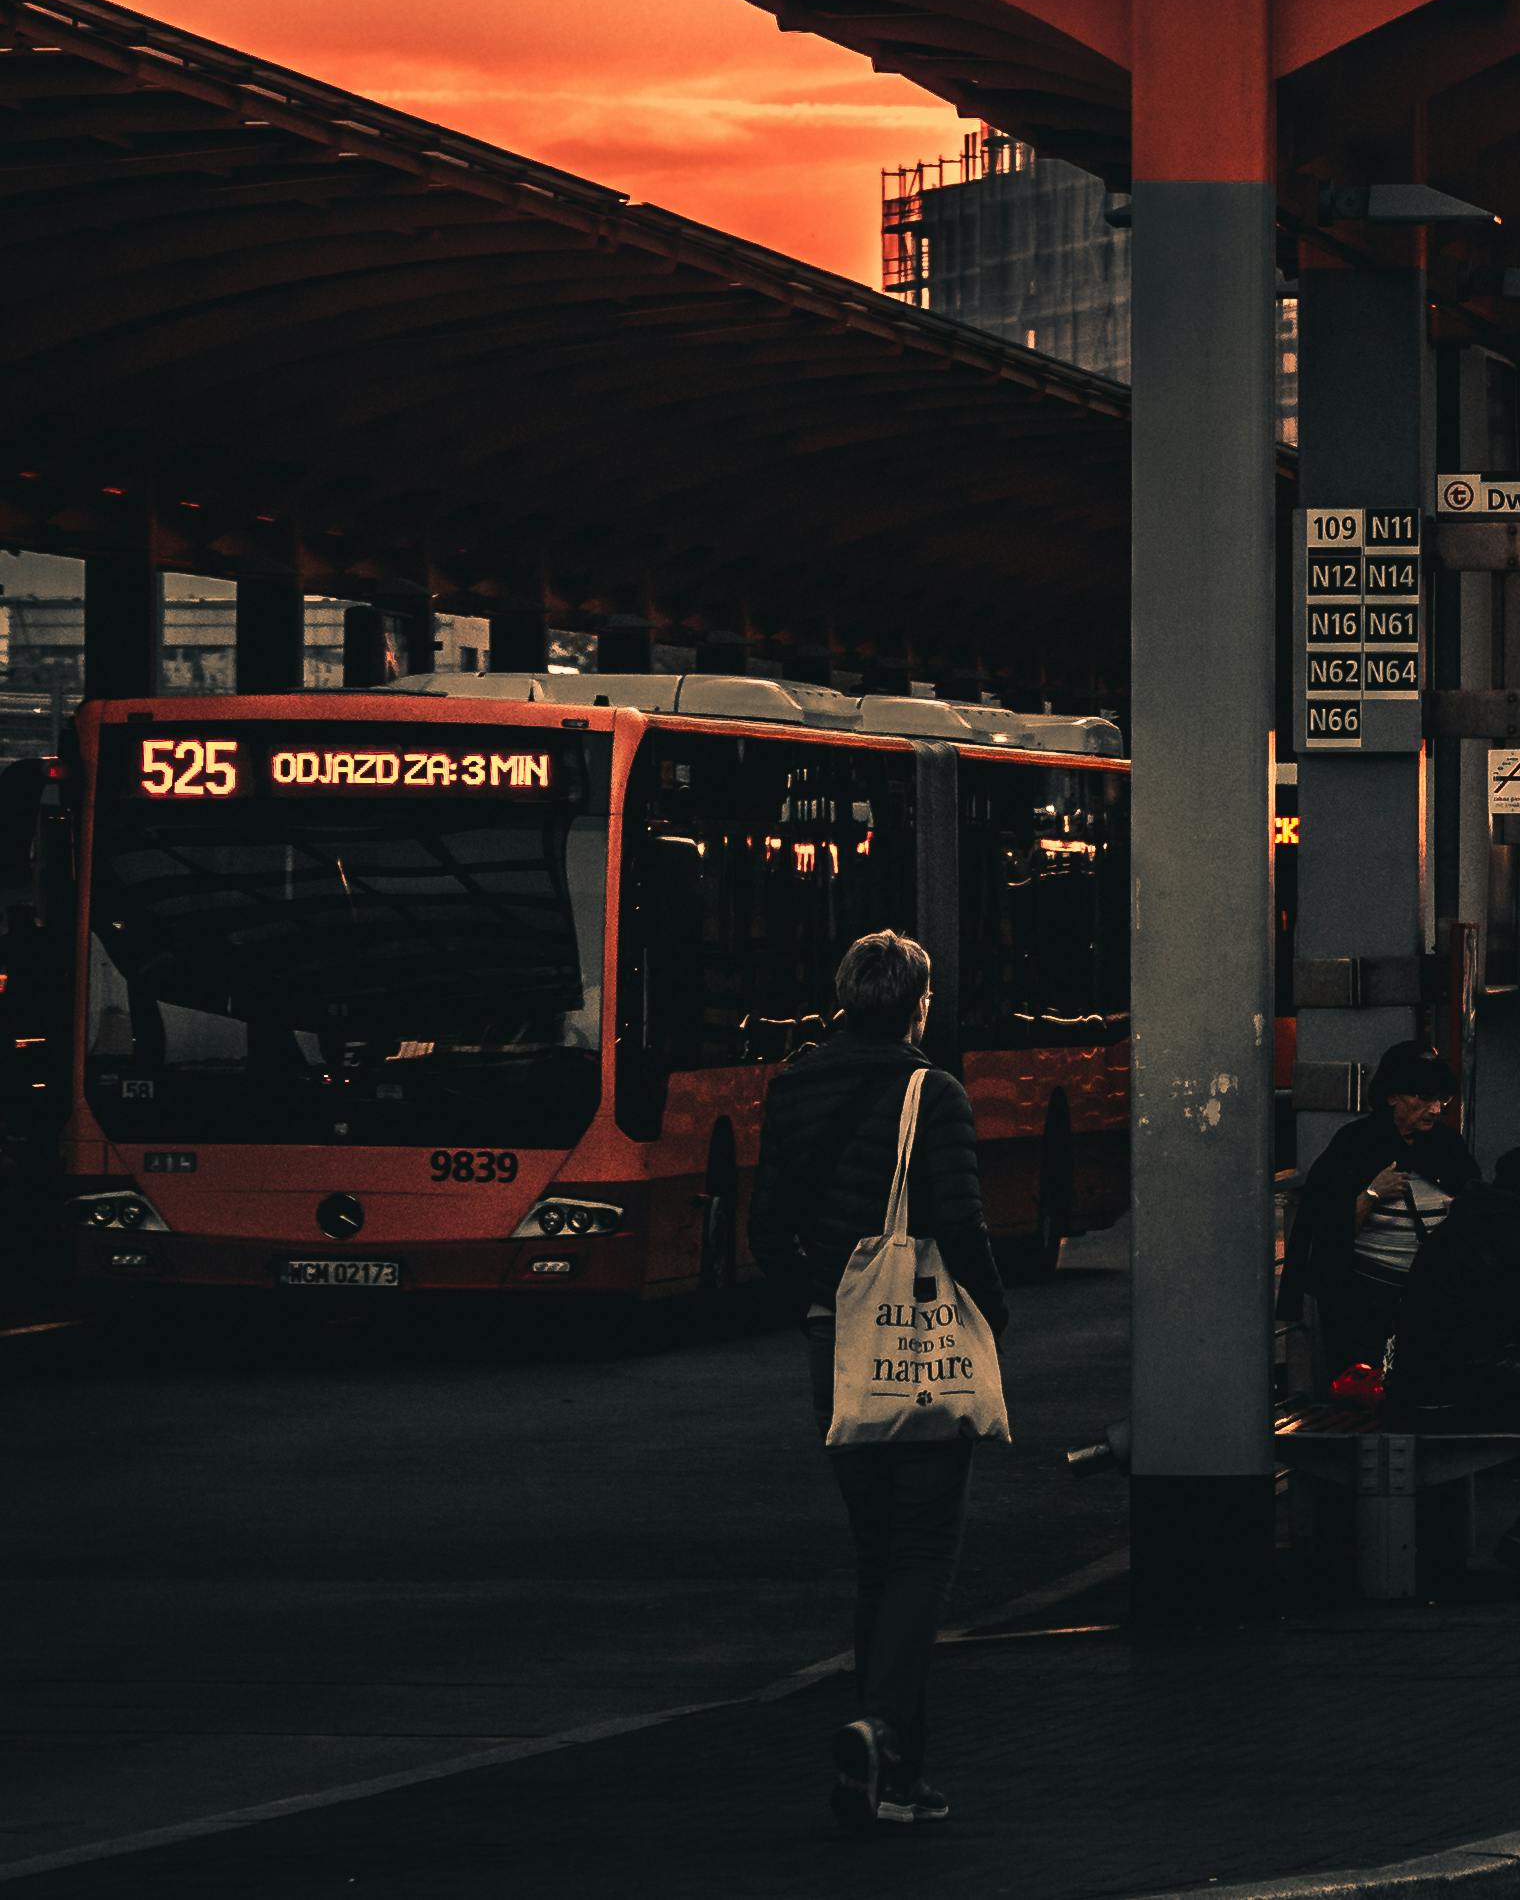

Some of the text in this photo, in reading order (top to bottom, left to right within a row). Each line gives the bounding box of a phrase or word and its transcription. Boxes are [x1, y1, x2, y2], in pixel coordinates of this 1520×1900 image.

[1313, 516, 1357, 540] 109
[1371, 516, 1414, 539] N11
[1312, 565, 1357, 588] N12
[1368, 564, 1415, 588] N14
[1311, 612, 1358, 636] N16
[1369, 612, 1414, 636] N61
[1310, 660, 1359, 684] N62
[1367, 660, 1417, 684] N64
[1309, 708, 1359, 732] N66
[141, 740, 238, 796] 525
[273, 752, 400, 785] ODJAZD
[460, 754, 486, 786] 3
[489, 754, 549, 787] MIN
[430, 1150, 518, 1183] 9839
[289, 1263, 397, 1284] WGM 02173
